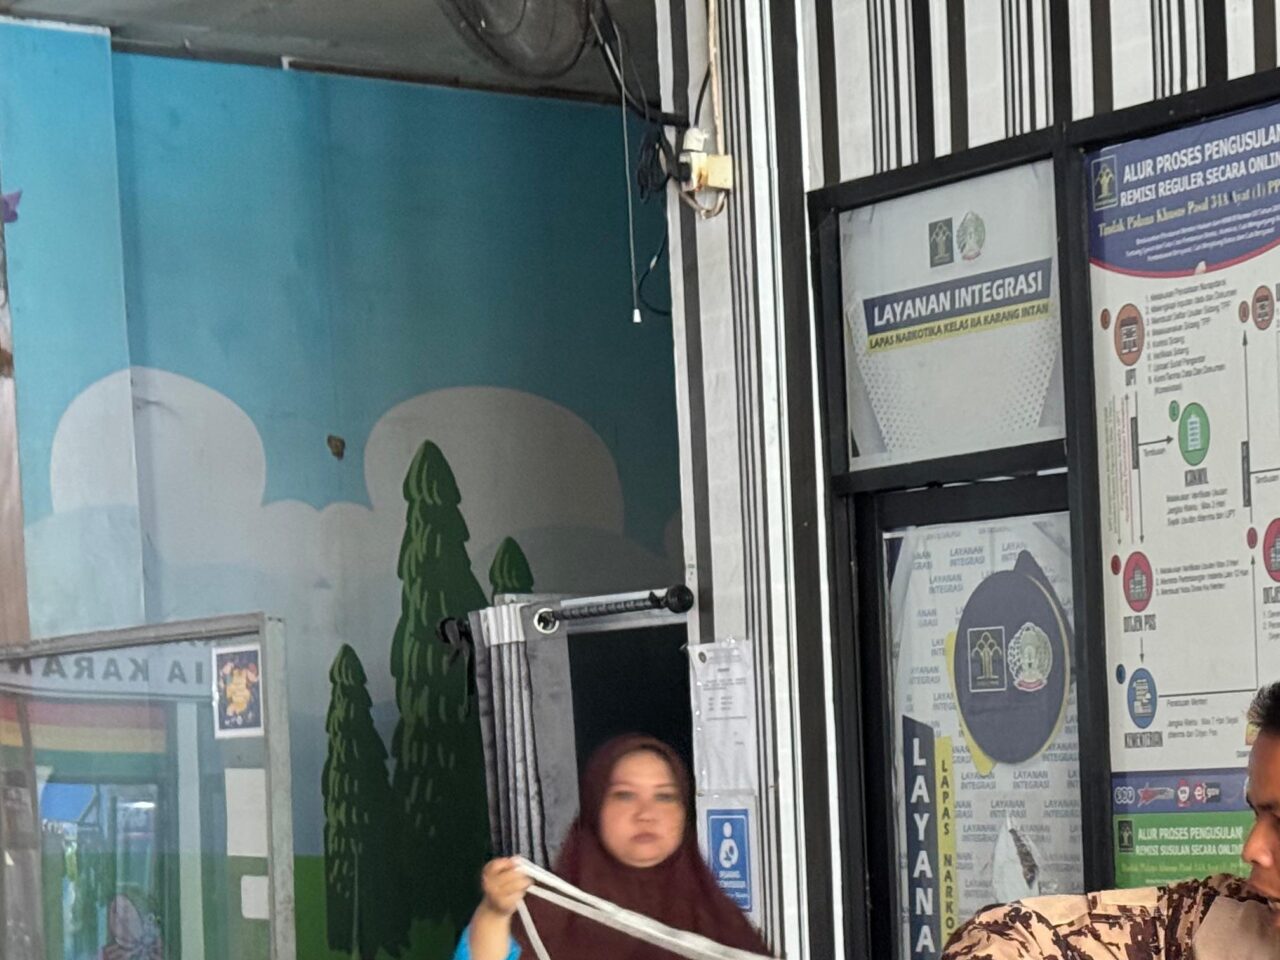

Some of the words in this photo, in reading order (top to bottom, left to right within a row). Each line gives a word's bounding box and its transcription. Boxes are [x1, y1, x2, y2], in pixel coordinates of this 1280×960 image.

[1124, 157, 1154, 183] ALUR
[1157, 145, 1202, 174] PROSES
[1120, 183, 1156, 207] REMISI
[1158, 171, 1204, 197] REGULER
[1206, 160, 1246, 185] SECARA
[874, 291, 950, 327] LAYANAN
[955, 270, 1042, 310] INTEGRASI
[870, 334, 894, 349] LAPAS
[1014, 771, 1048, 779] LAYANAN
[940, 760, 951, 835] LAPAS
[1138, 828, 1159, 840] ALUR
[1160, 827, 1188, 840] PROSES
